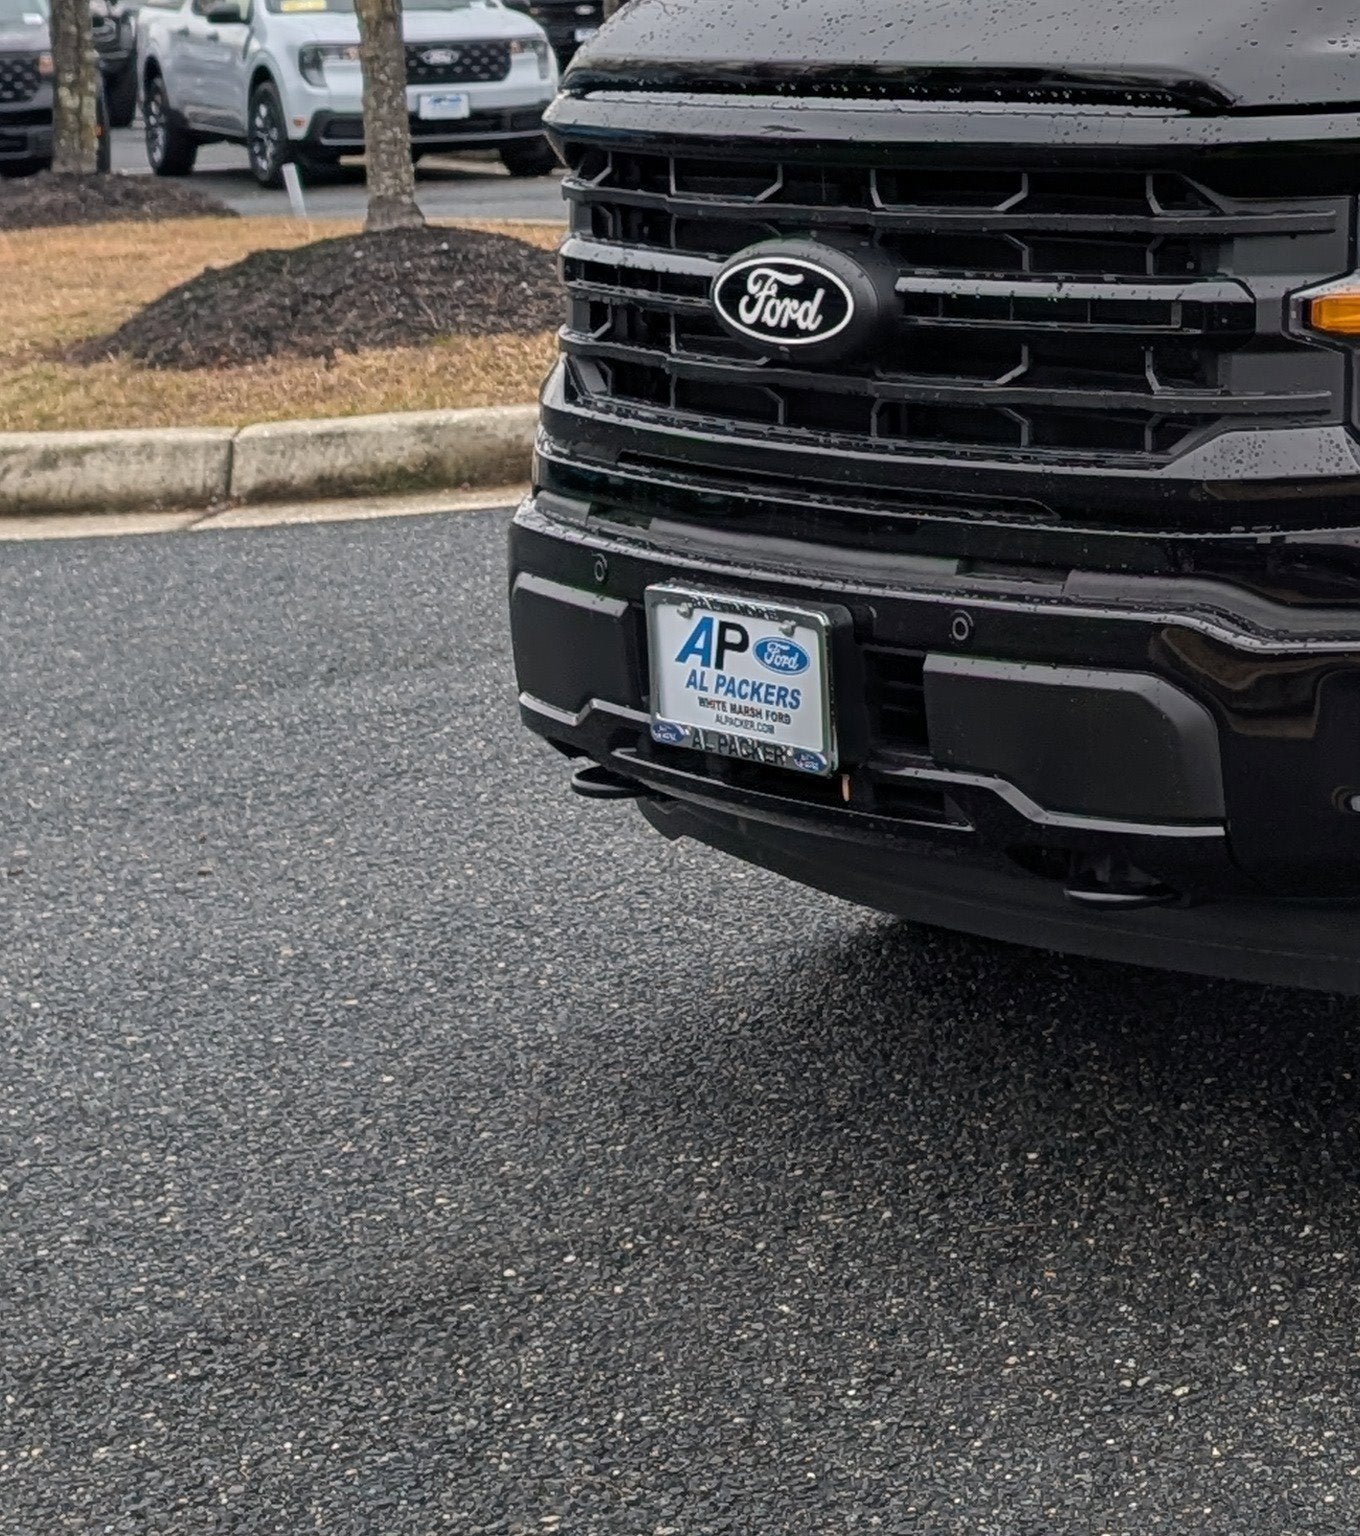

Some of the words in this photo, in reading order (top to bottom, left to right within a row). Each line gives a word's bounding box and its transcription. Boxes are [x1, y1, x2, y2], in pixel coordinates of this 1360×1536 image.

[739, 267, 826, 331] Ford
[675, 616, 749, 670] AP
[764, 641, 800, 670] Ford
[685, 669, 709, 692] AL
[714, 674, 802, 710] PACKERS
[730, 702, 763, 720] MARSH
[765, 708, 791, 725] FORD
[692, 727, 716, 751] AL
